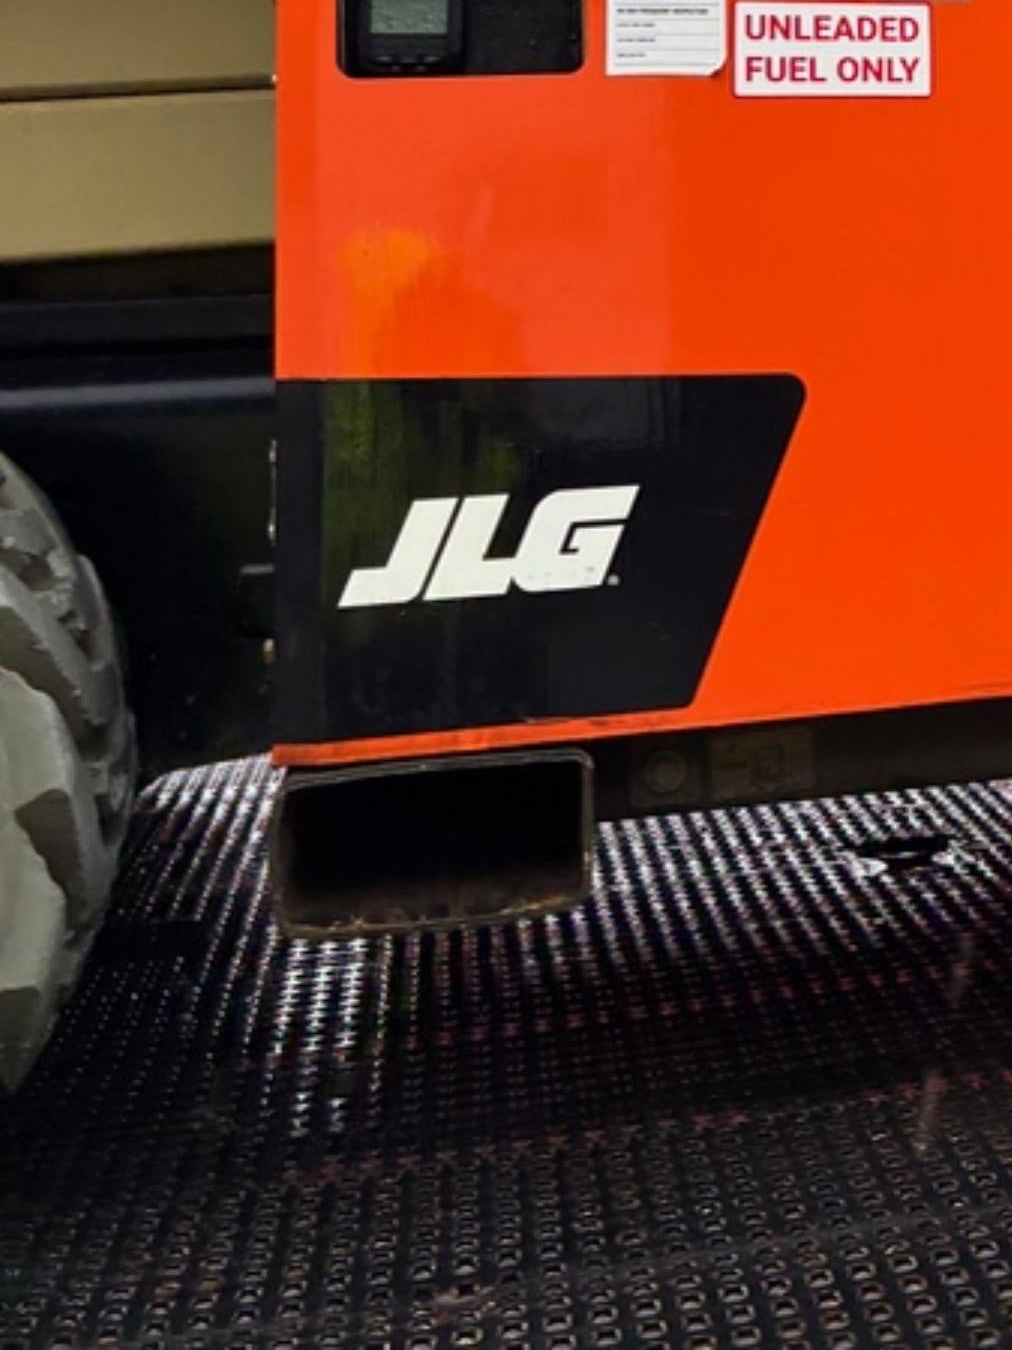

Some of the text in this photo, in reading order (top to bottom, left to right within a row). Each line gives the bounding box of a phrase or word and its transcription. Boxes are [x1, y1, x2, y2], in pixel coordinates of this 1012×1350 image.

[744, 15, 920, 42] UNLEADED
[745, 56, 920, 83] FUEL ONLY
[338, 485, 640, 609] JLG
